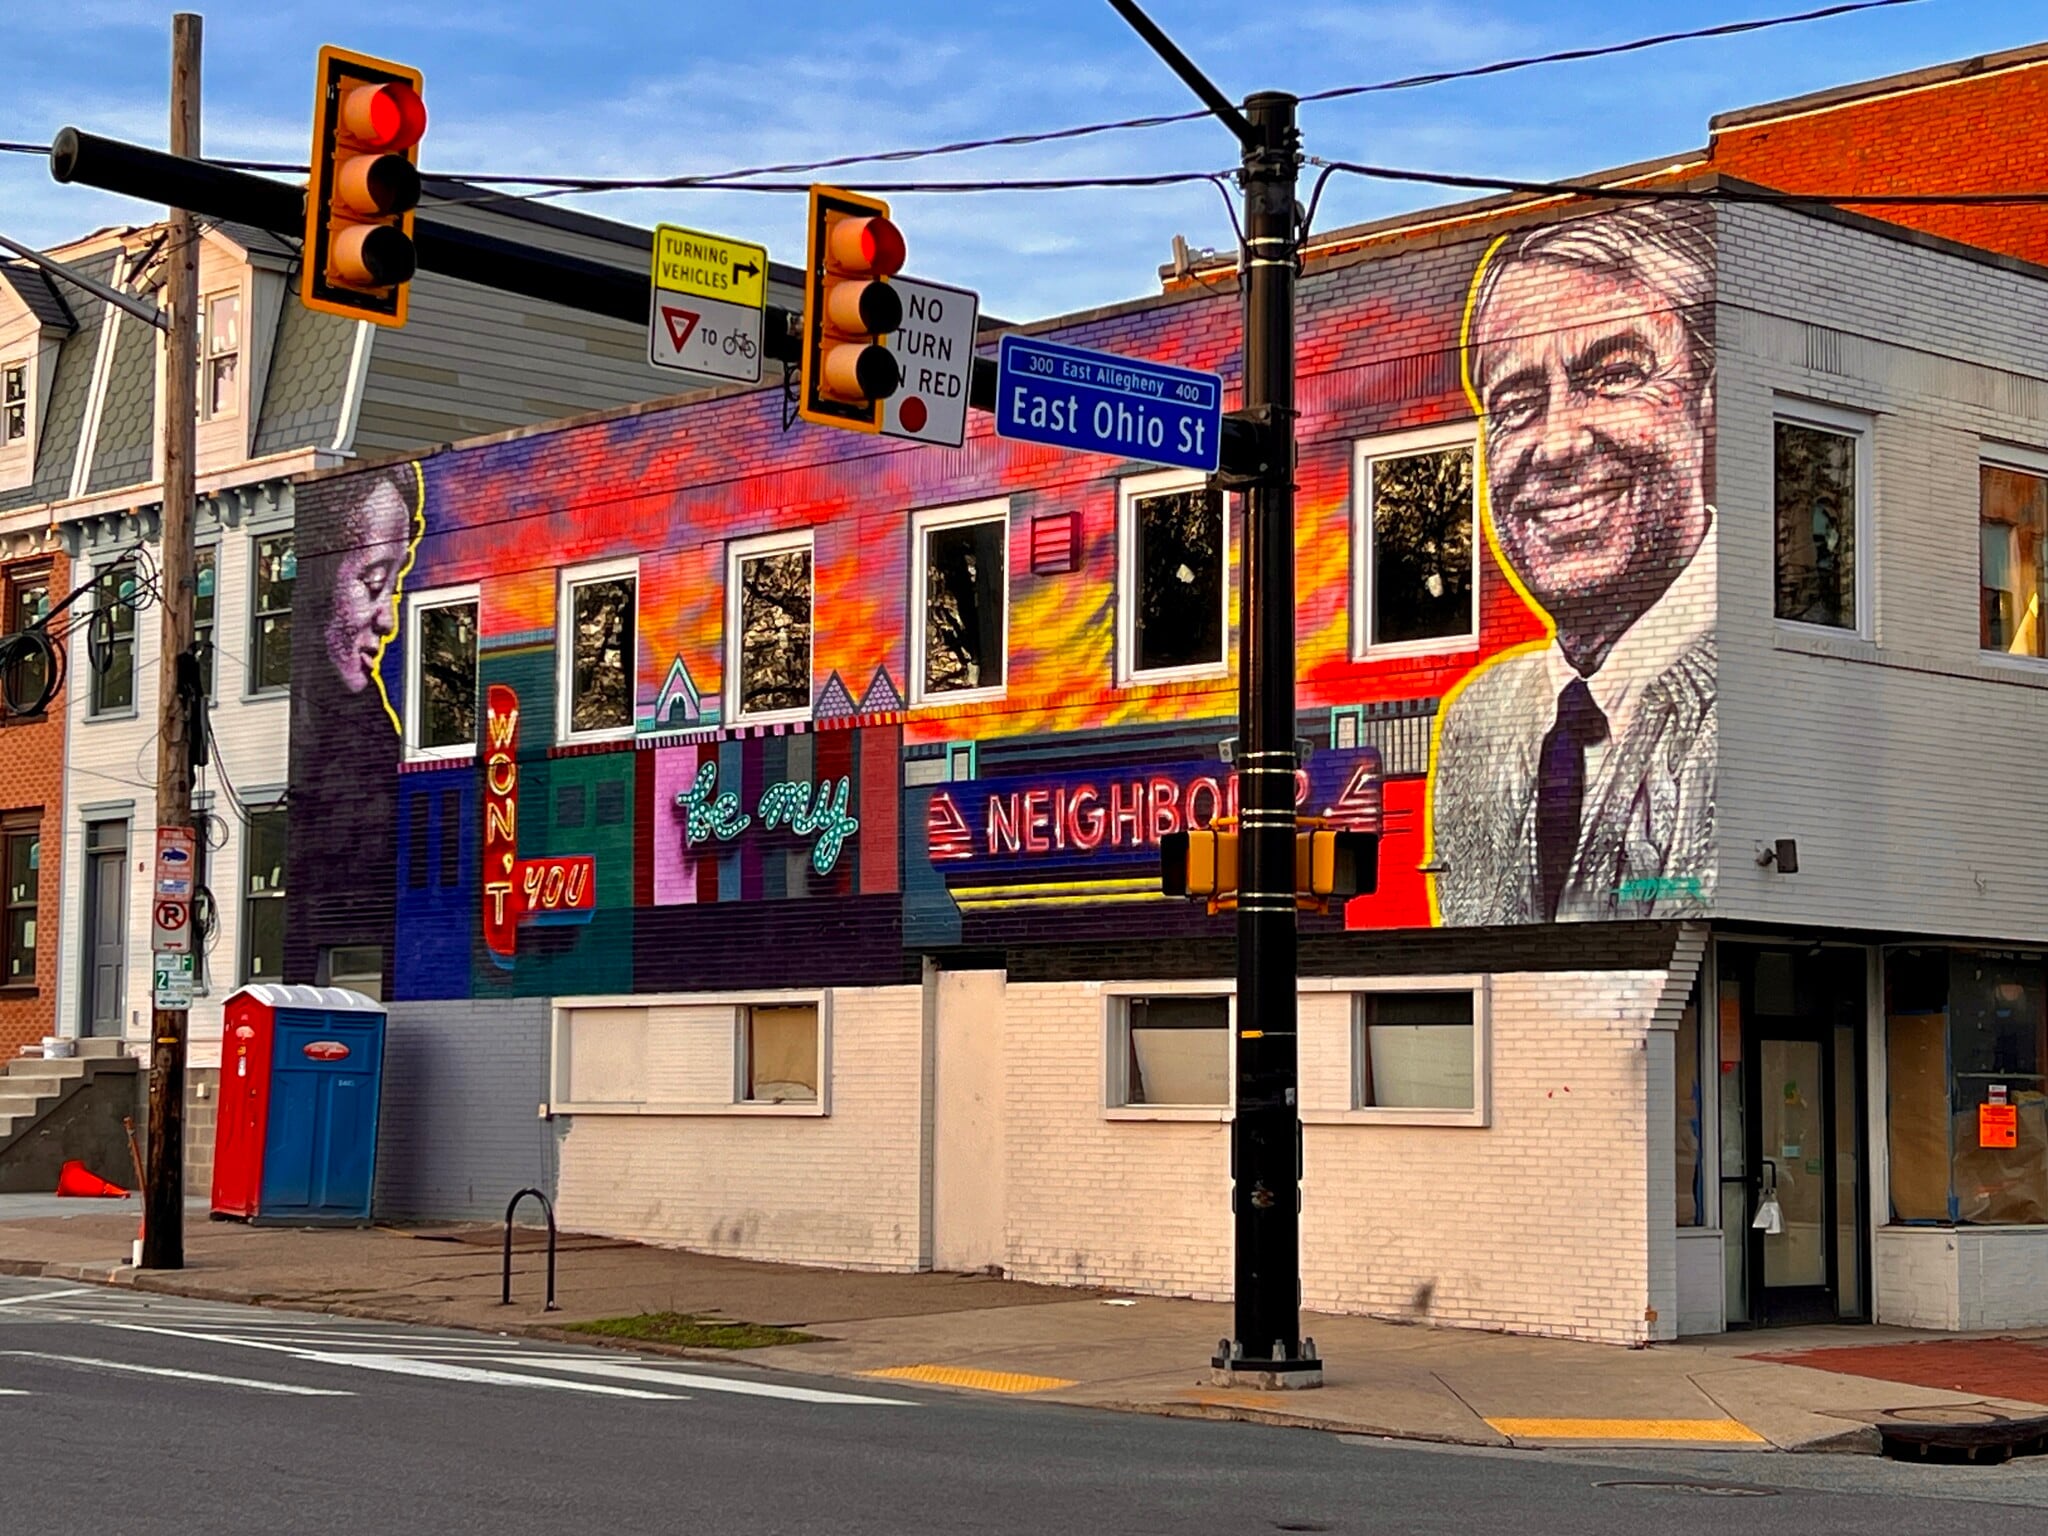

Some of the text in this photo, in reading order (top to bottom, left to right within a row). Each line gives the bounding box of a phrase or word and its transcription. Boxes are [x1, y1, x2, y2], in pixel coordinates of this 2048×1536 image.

[665, 237, 729, 266] TURNING
[661, 262, 729, 290] VEHICLES
[909, 294, 943, 323] NO
[701, 328, 718, 346] TO
[896, 327, 952, 362] TURN
[919, 368, 961, 398] RED
[1029, 356, 1200, 401] 300 East Allegheny 400
[1012, 386, 1206, 456] East Ohio St
[758, 775, 859, 876] my
[523, 862, 590, 911] YOU
[157, 971, 168, 989] 2
